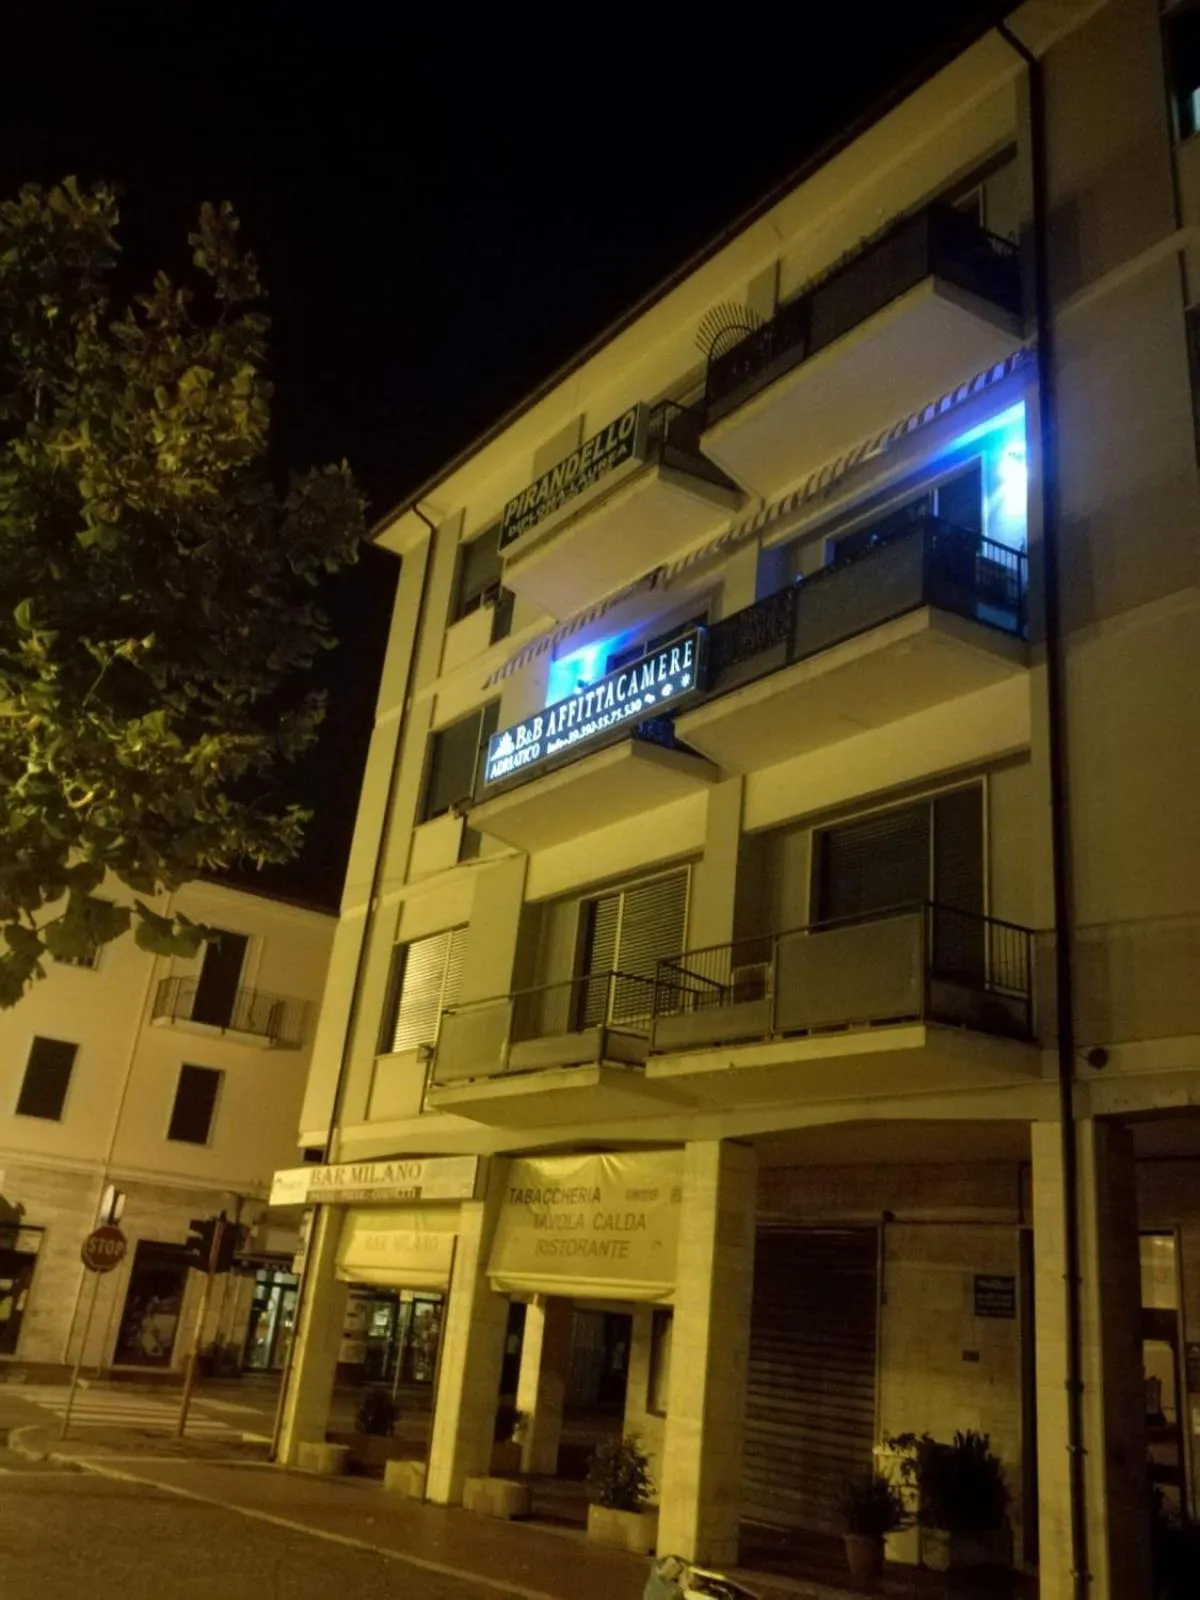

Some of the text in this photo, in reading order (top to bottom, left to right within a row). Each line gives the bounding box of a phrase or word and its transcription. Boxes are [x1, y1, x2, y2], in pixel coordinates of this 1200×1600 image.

[505, 410, 635, 527] PIRANDELLO
[515, 640, 693, 747] B&B AFFITTACAMERE
[490, 742, 541, 779] ADRIATICO
[310, 1167, 345, 1185] BAR
[351, 1162, 422, 1184] MILANO
[508, 1186, 601, 1205] TABACCHERIA
[533, 1212, 647, 1231] TAVOLA CALDA
[87, 1236, 125, 1257] STOP
[535, 1237, 632, 1259] RISTORANTE
